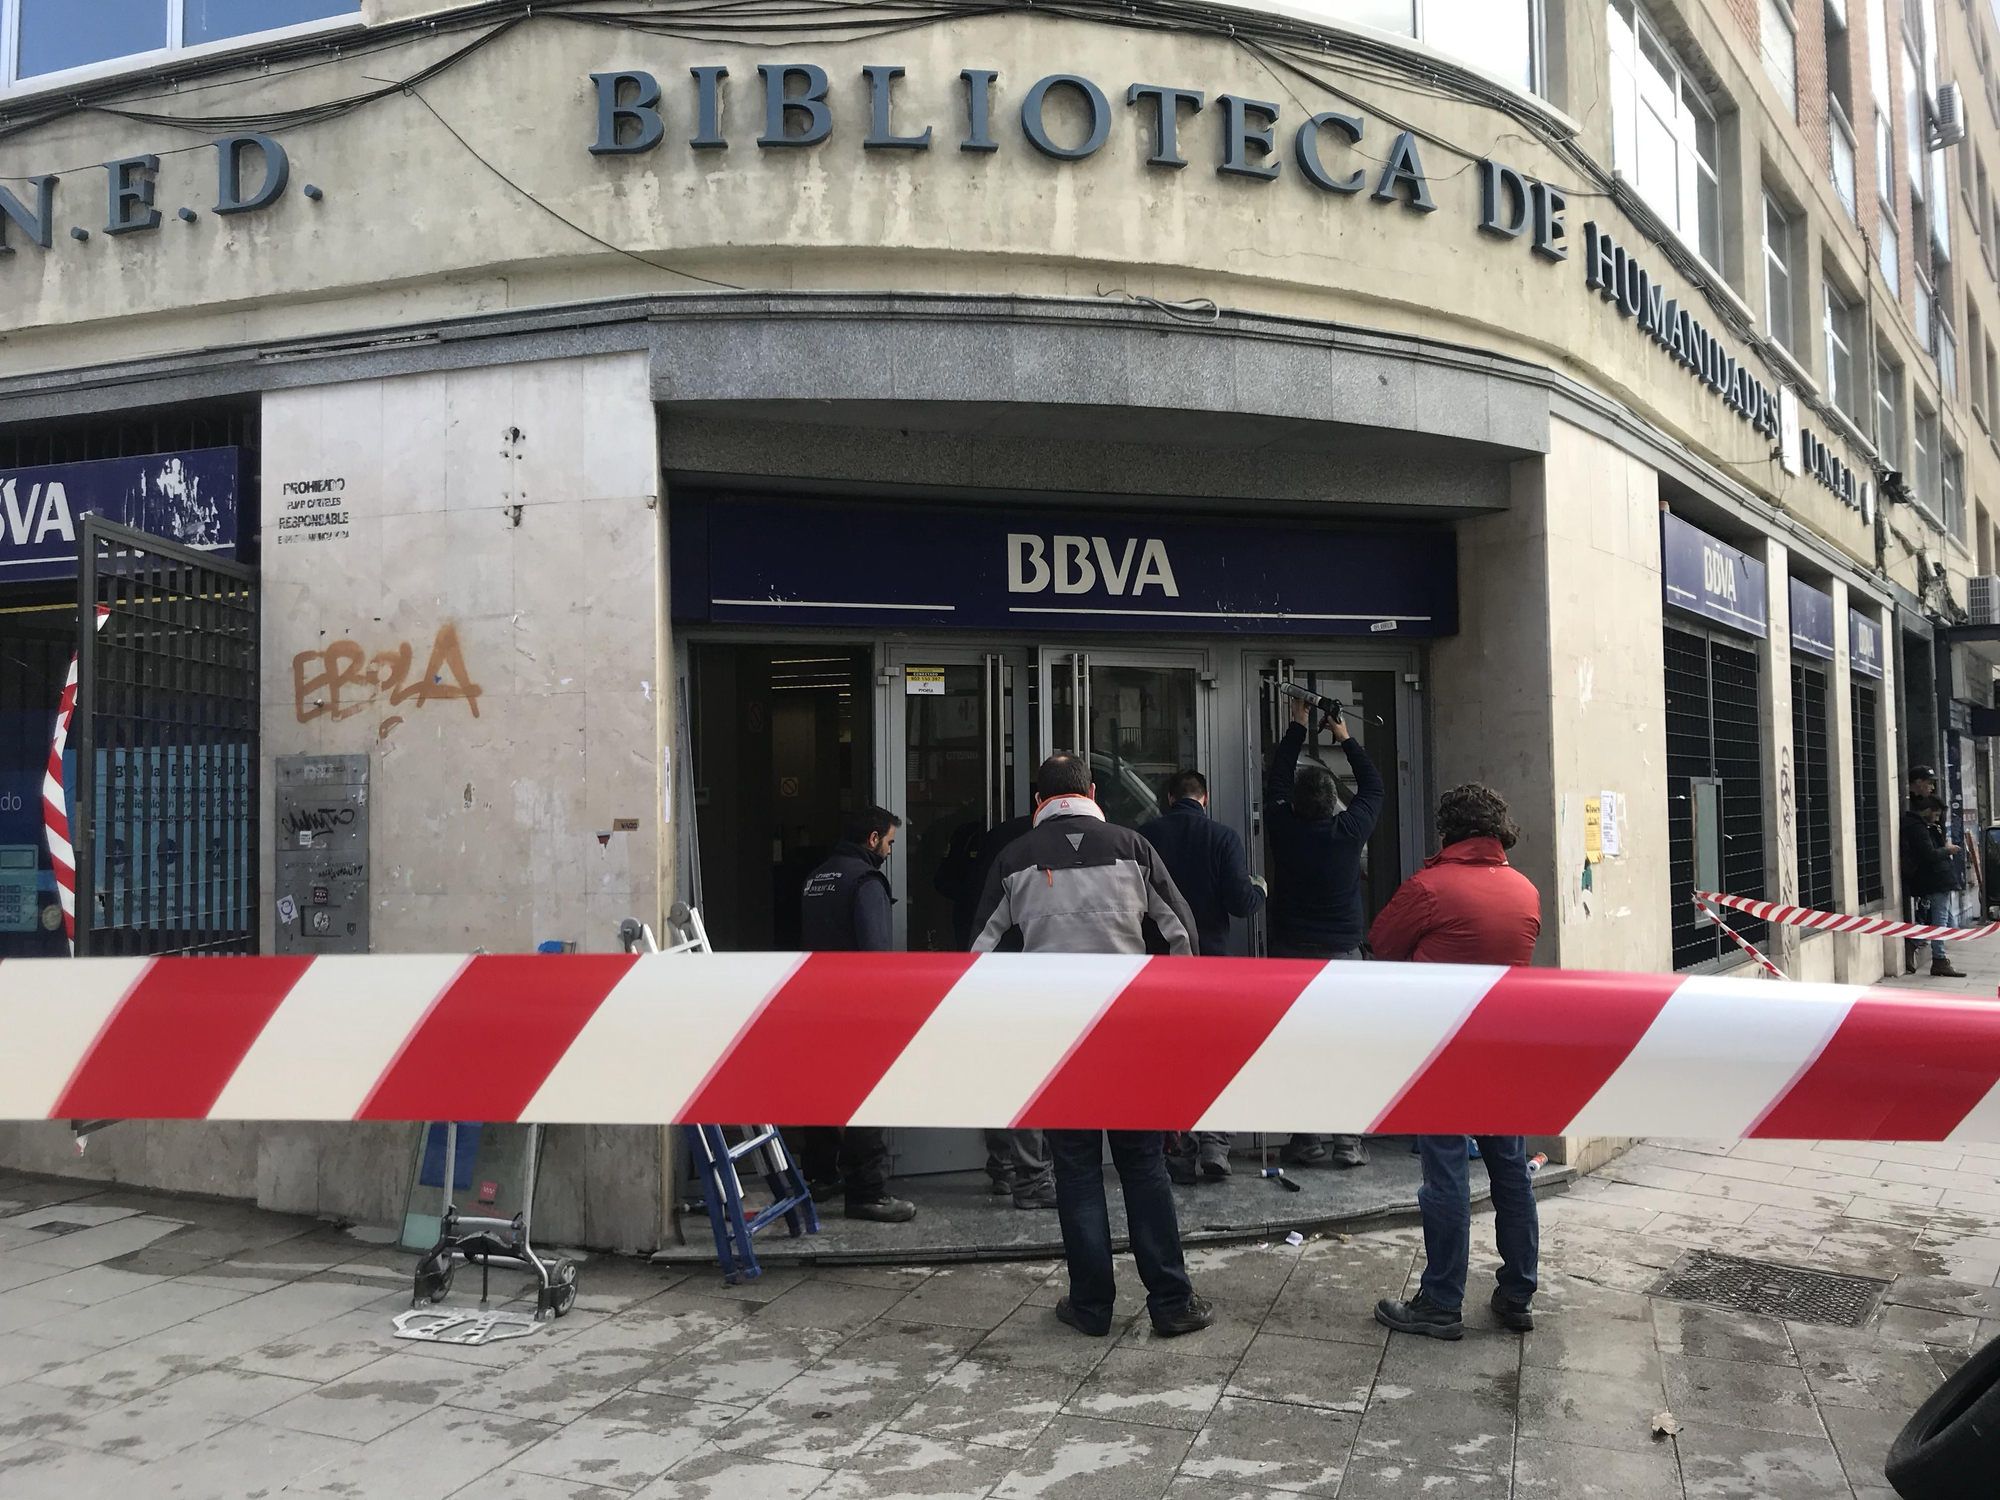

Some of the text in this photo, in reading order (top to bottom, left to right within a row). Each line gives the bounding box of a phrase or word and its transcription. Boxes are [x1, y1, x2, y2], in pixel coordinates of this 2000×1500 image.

[588, 63, 1779, 440] BIBLIOTECA DE HUMANIDADES
[1007, 533, 1180, 597] BBVA
[1703, 545, 1737, 603] BBVA
